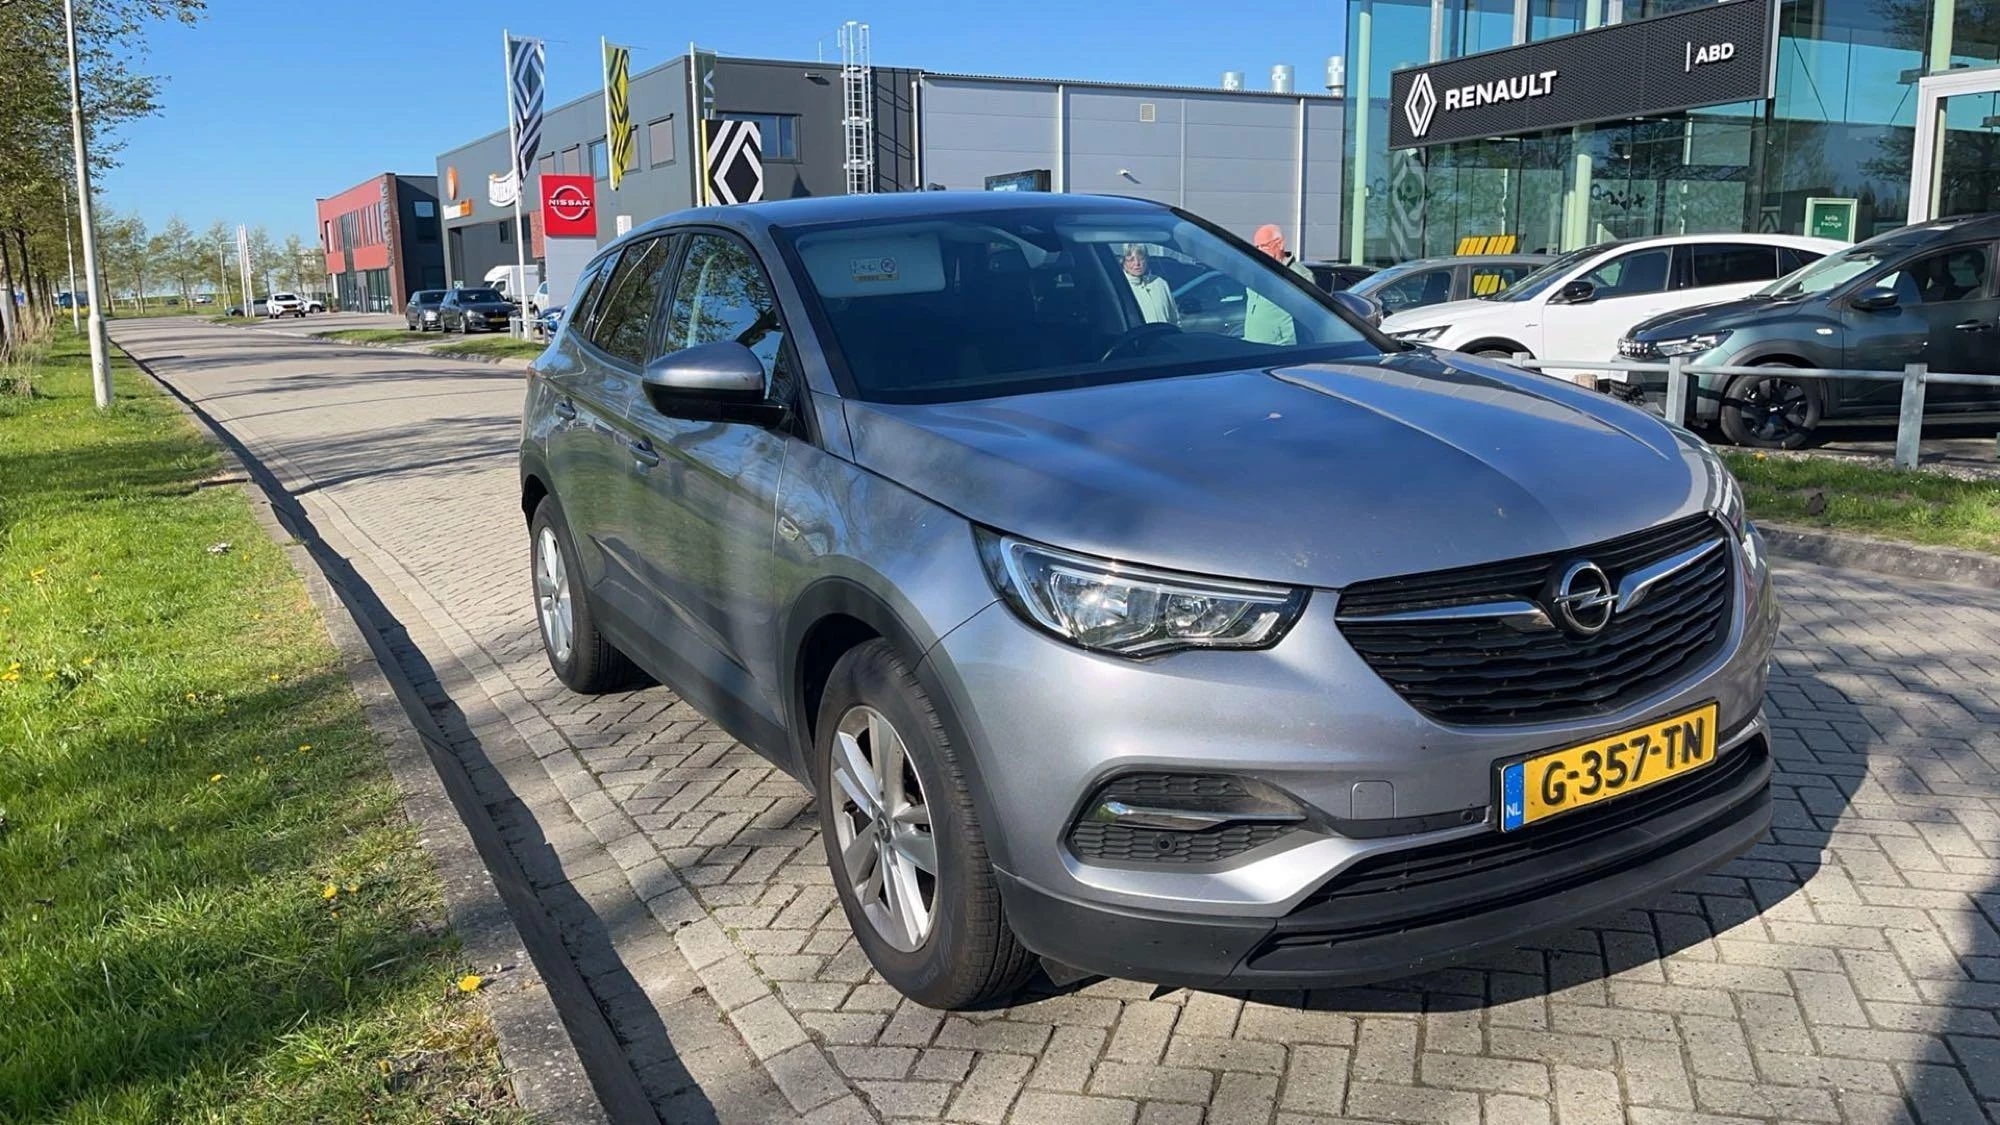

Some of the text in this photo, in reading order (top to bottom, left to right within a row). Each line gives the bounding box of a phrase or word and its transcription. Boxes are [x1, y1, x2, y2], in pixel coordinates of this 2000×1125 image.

[1695, 43, 1734, 64] ABD
[1445, 70, 1557, 110] RENAULT
[1542, 718, 1703, 805] G-357-TN
[1505, 802, 1522, 817] NL
